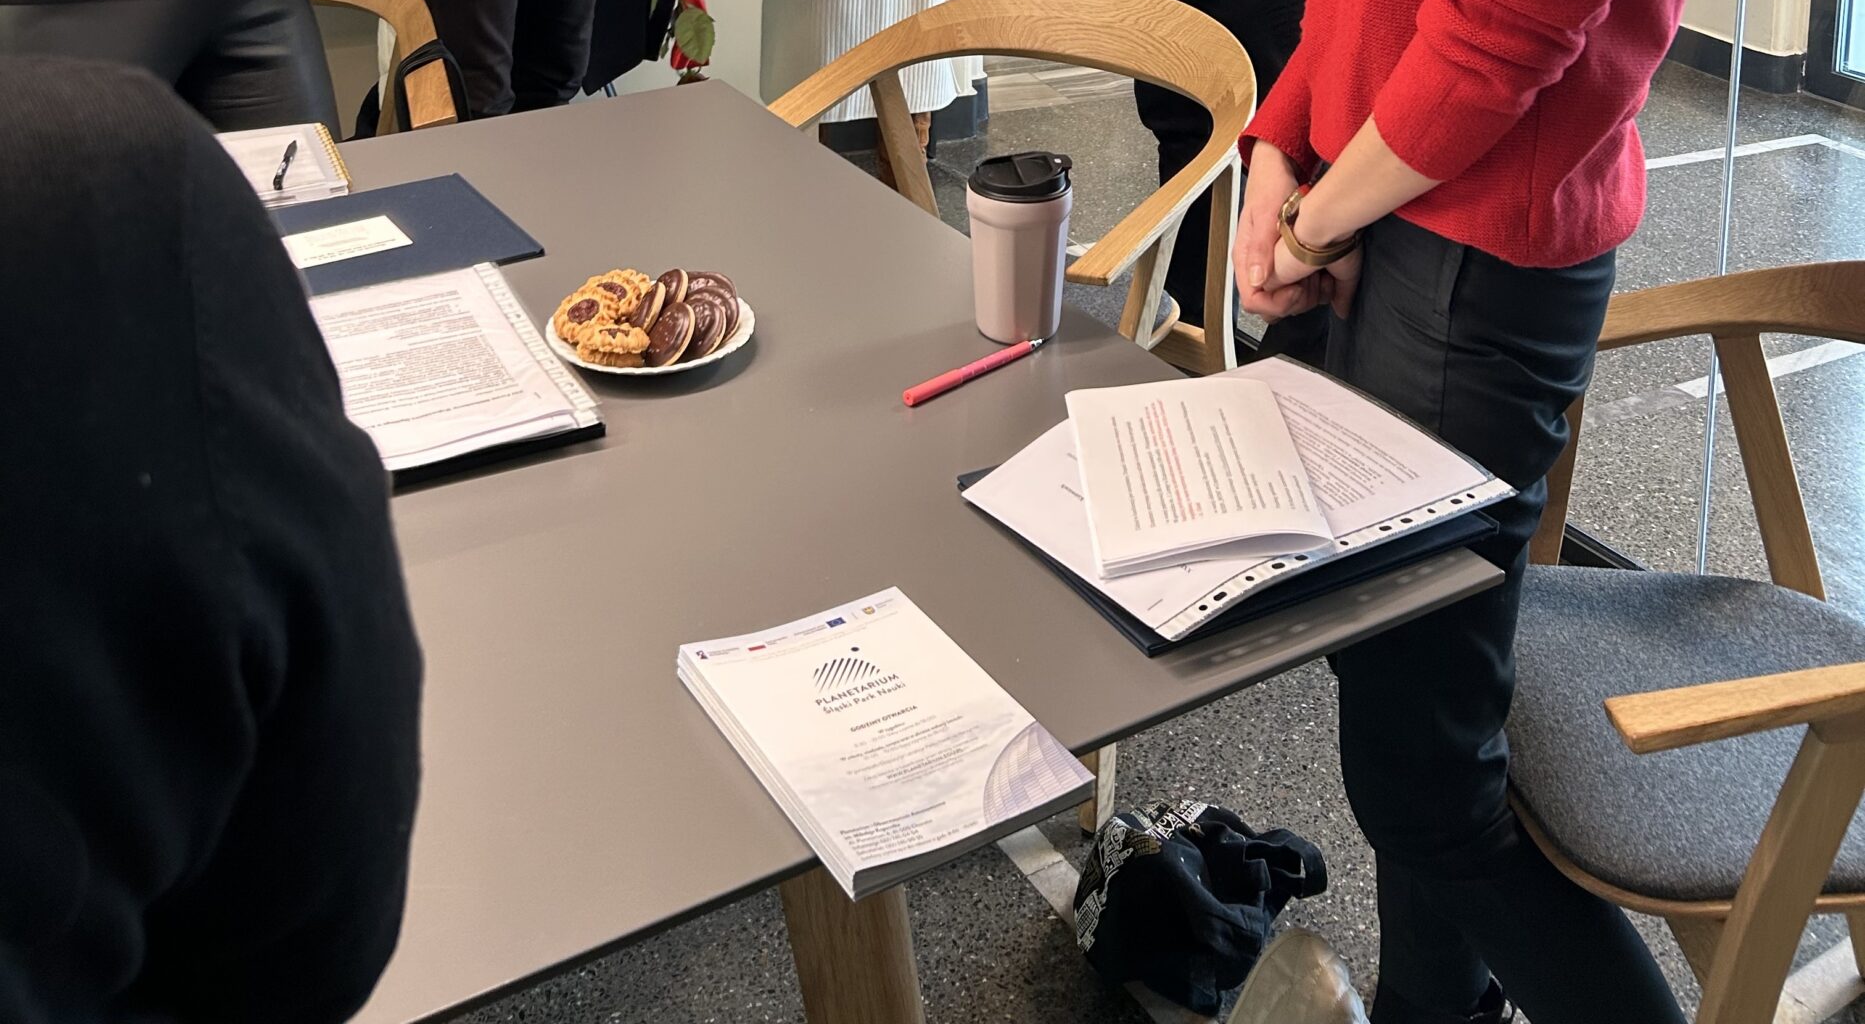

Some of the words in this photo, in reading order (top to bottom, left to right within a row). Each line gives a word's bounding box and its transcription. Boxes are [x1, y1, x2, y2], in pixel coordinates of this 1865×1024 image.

[815, 674, 899, 706] PLANETARIUM
[823, 702, 853, 715] Śląski
[853, 693, 876, 704] Park
[877, 682, 906, 696] Nauki
